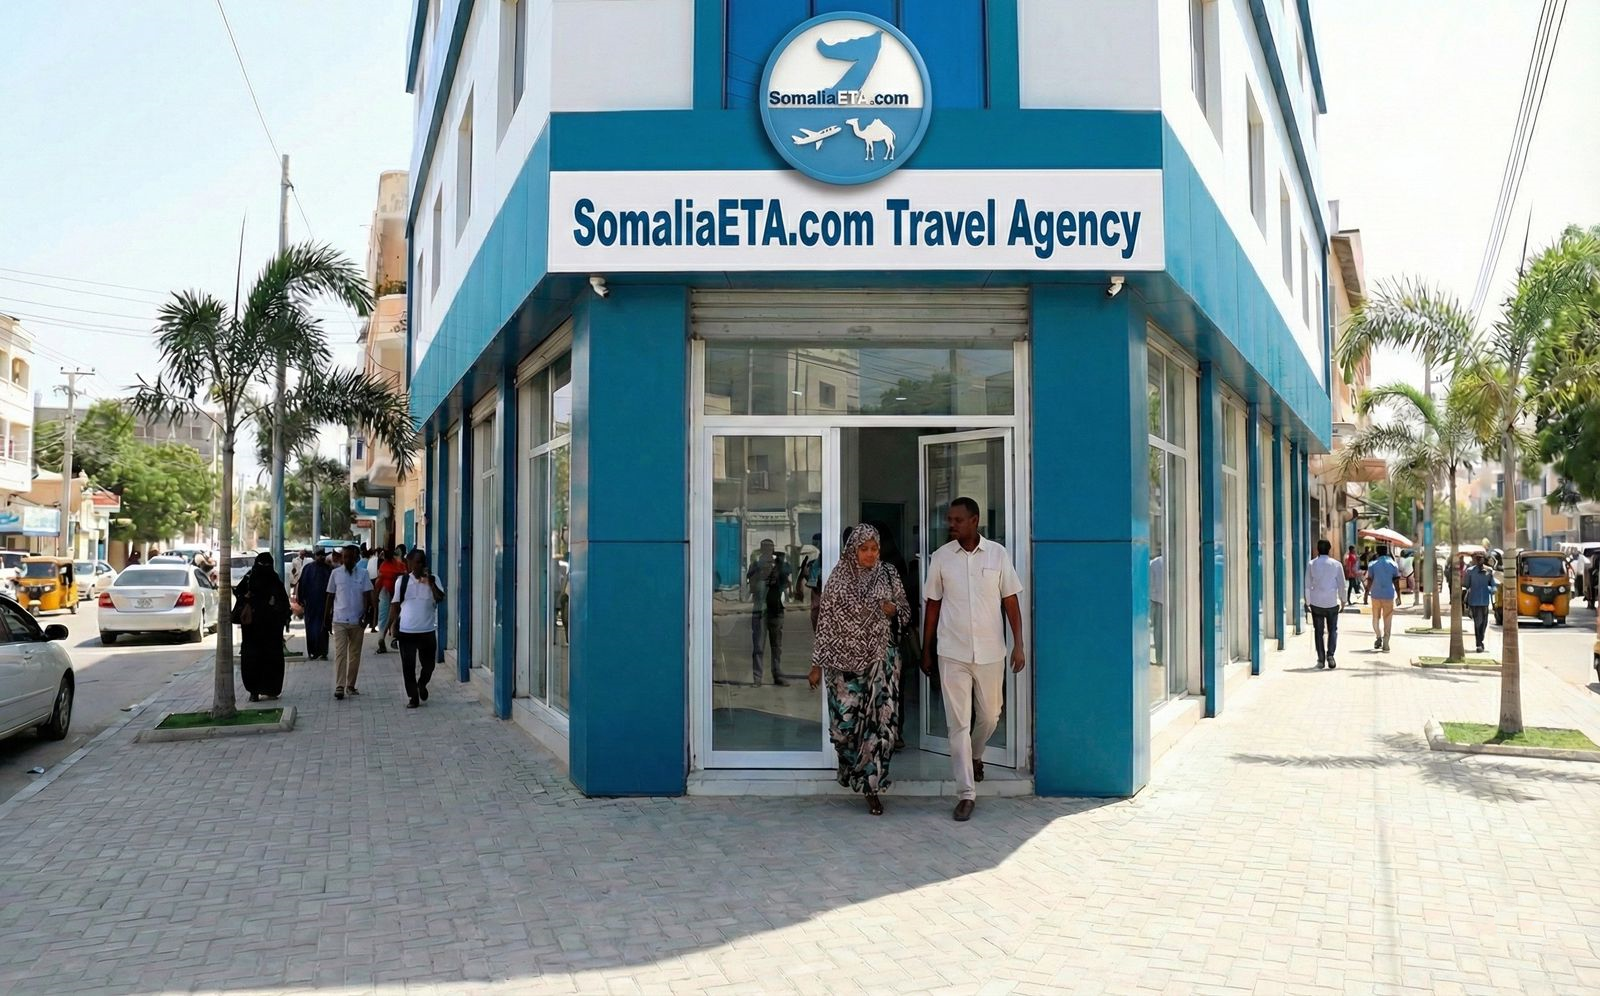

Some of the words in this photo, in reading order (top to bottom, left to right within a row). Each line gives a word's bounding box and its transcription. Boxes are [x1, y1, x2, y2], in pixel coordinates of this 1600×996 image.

[769, 90, 909, 106] SomaliaETA.com
[573, 198, 874, 247] SomaliaETA.com
[886, 198, 996, 247] Travel
[1007, 198, 1142, 260] Agency
